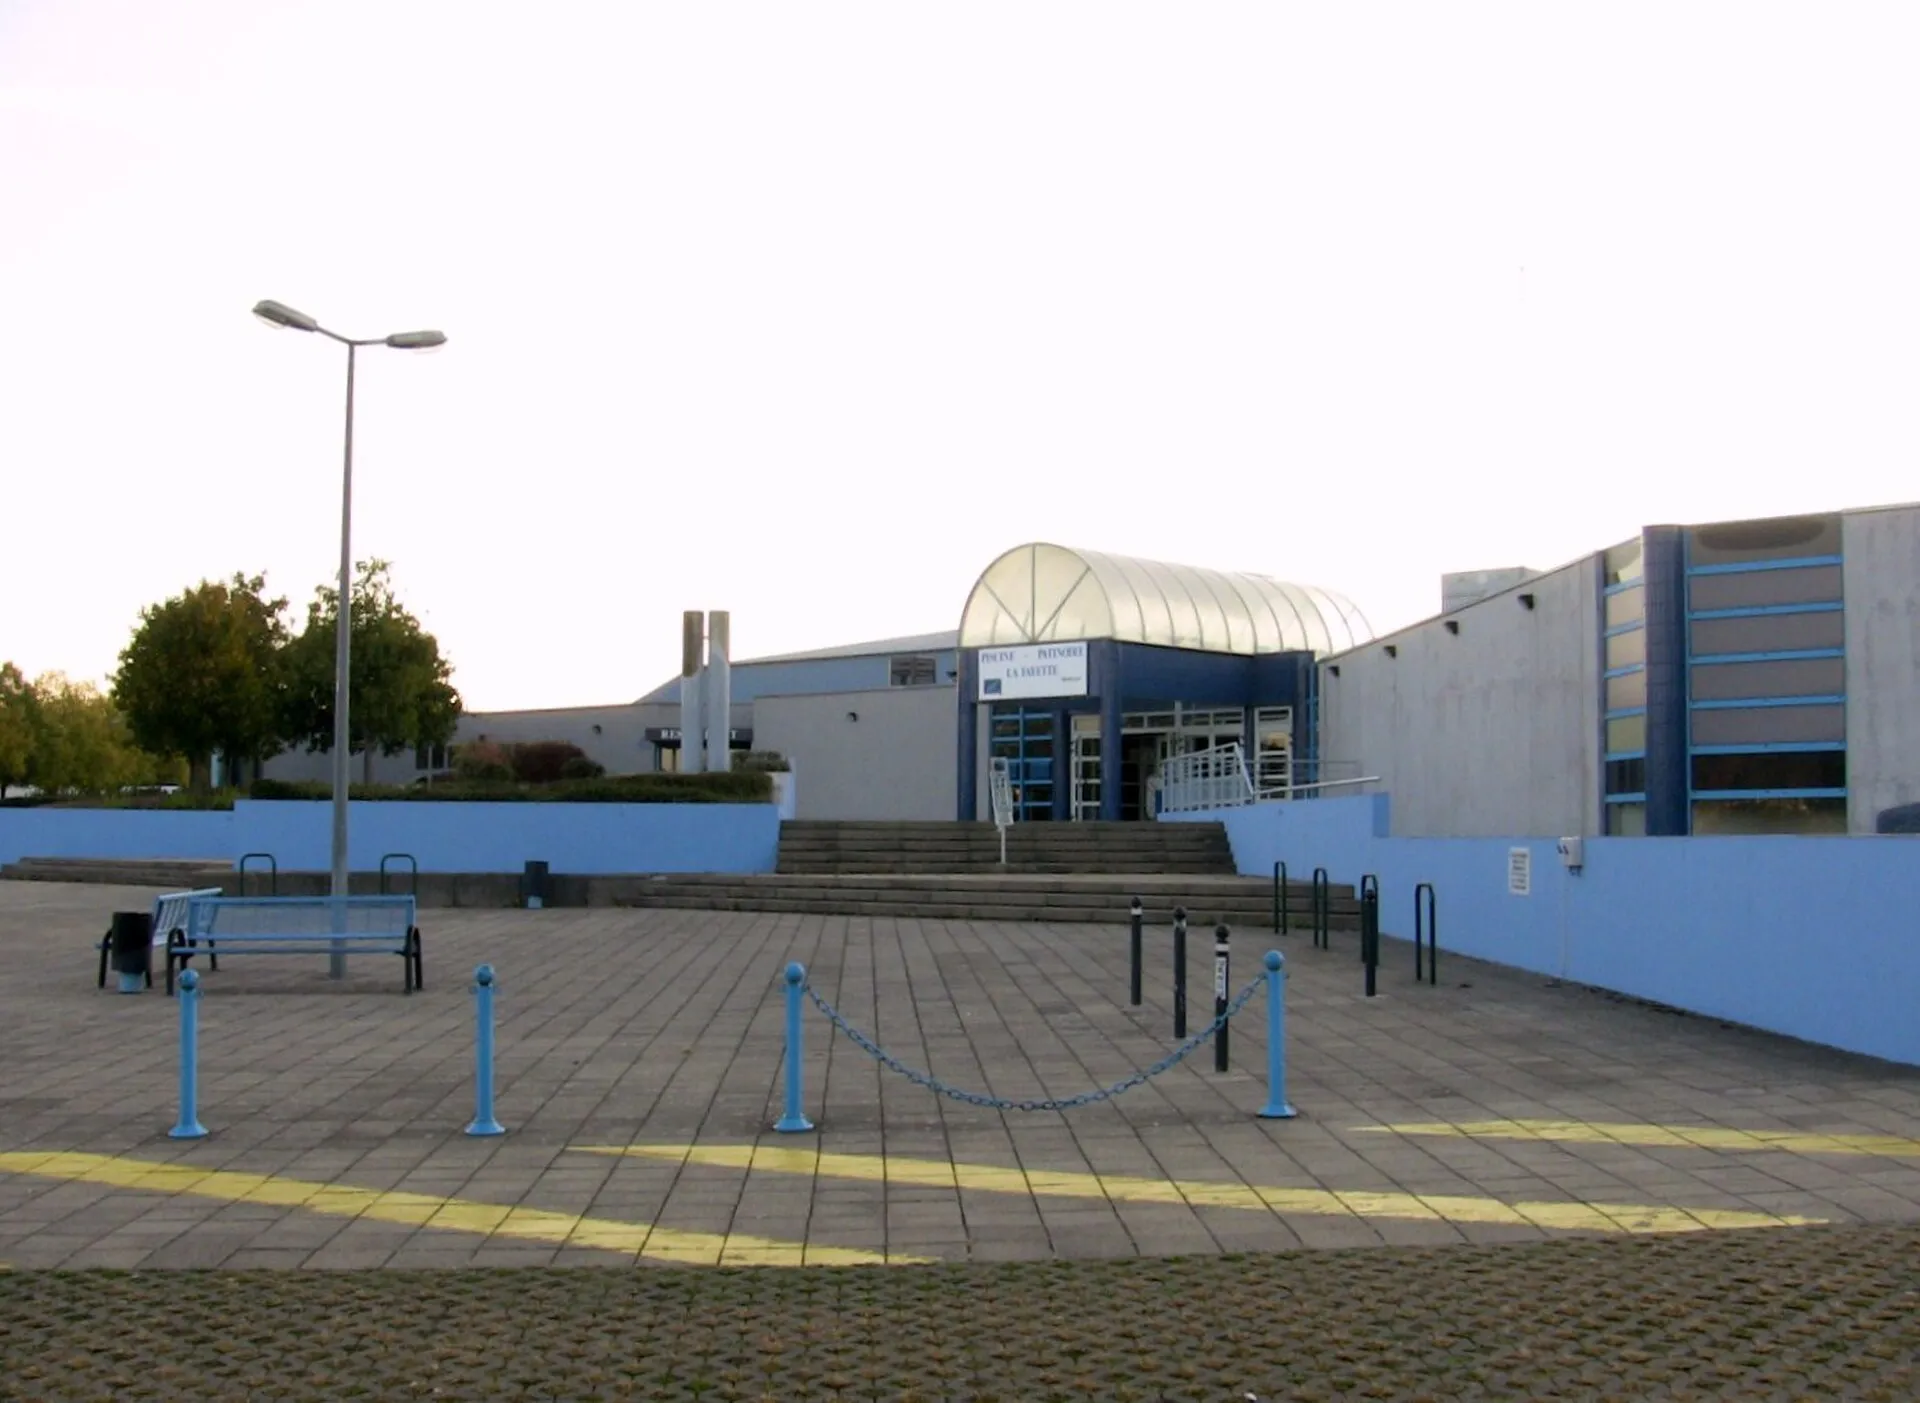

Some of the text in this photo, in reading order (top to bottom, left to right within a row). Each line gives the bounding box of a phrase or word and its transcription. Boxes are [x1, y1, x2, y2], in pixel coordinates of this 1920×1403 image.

[981, 651, 1016, 663] PISCINE
[1006, 664, 1058, 678] LA FAYETTE
